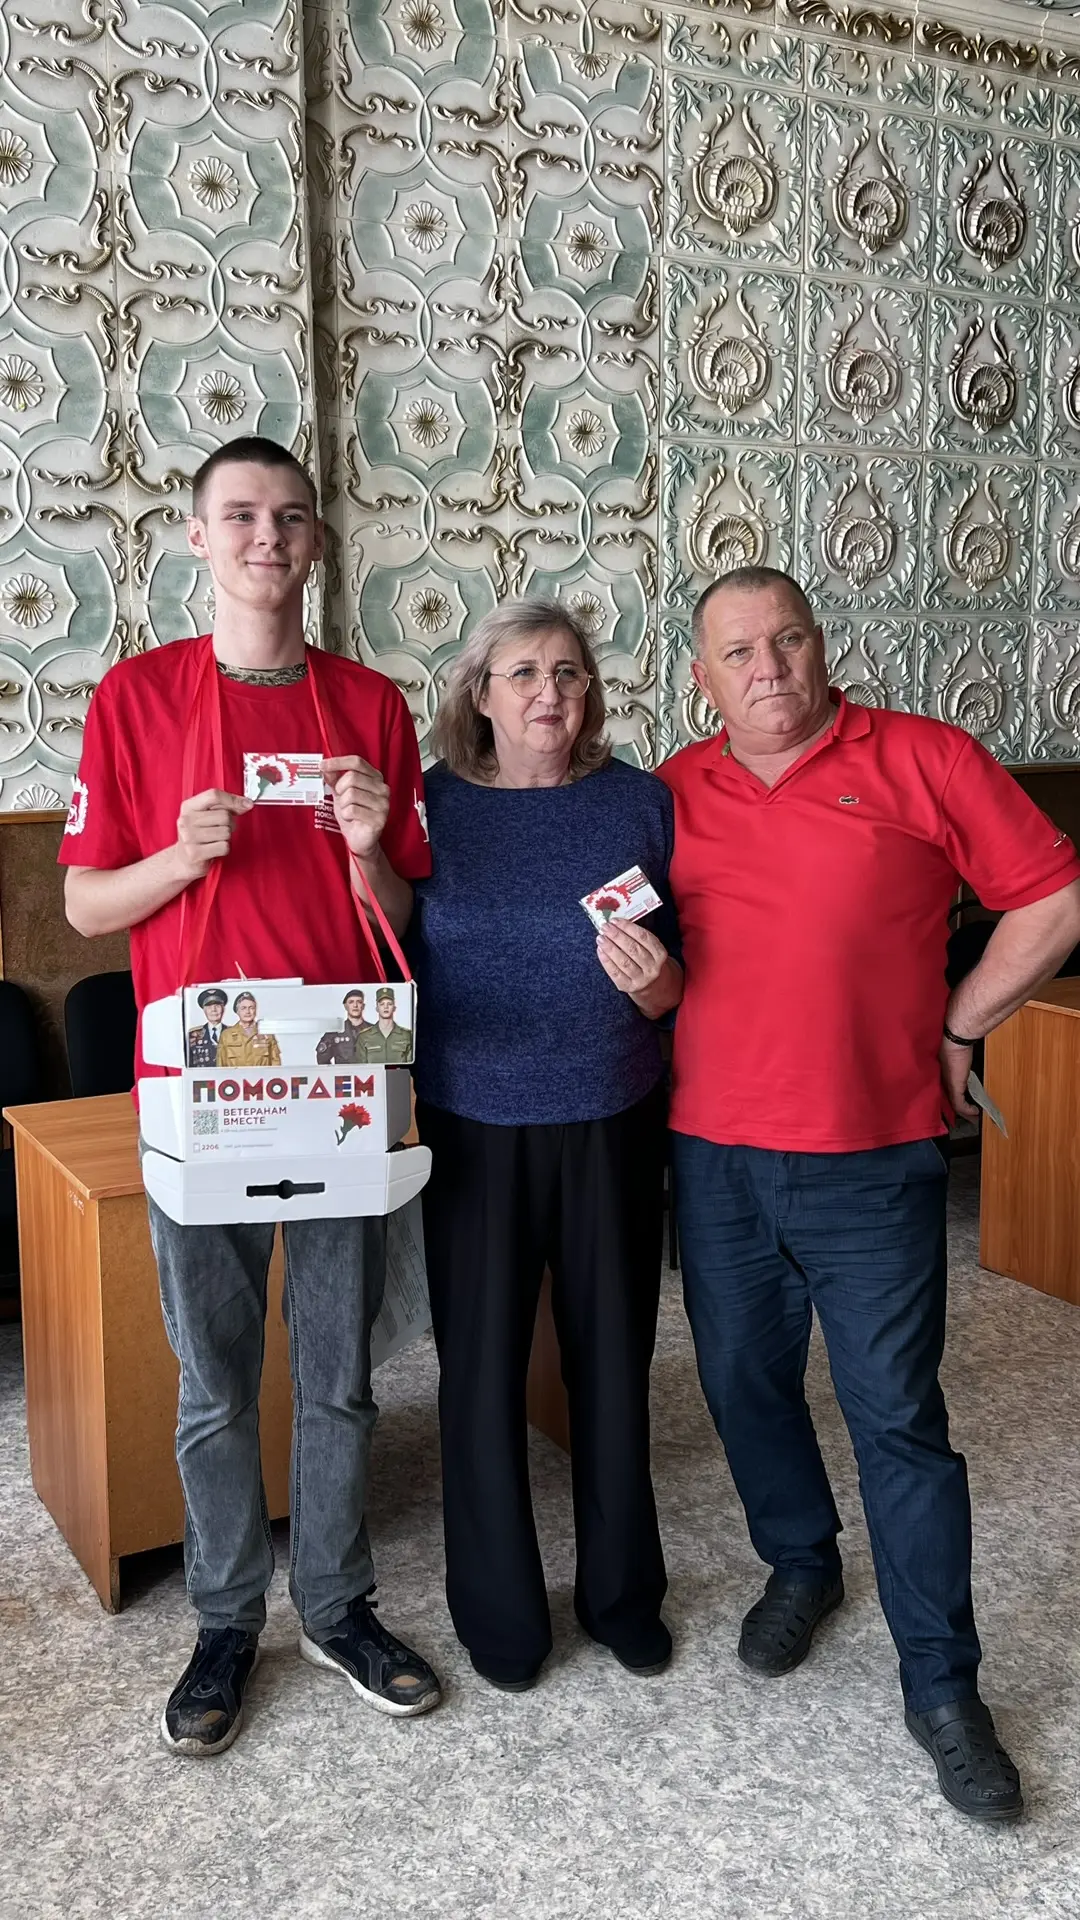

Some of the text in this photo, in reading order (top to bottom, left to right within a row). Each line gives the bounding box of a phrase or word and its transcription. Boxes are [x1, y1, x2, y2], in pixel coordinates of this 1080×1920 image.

[193, 1075, 374, 1102] ПОМОГАЕМ
[223, 1106, 287, 1116] ВЕТЕРАНАМ
[223, 1117, 266, 1125] ВМЕСТЕ
